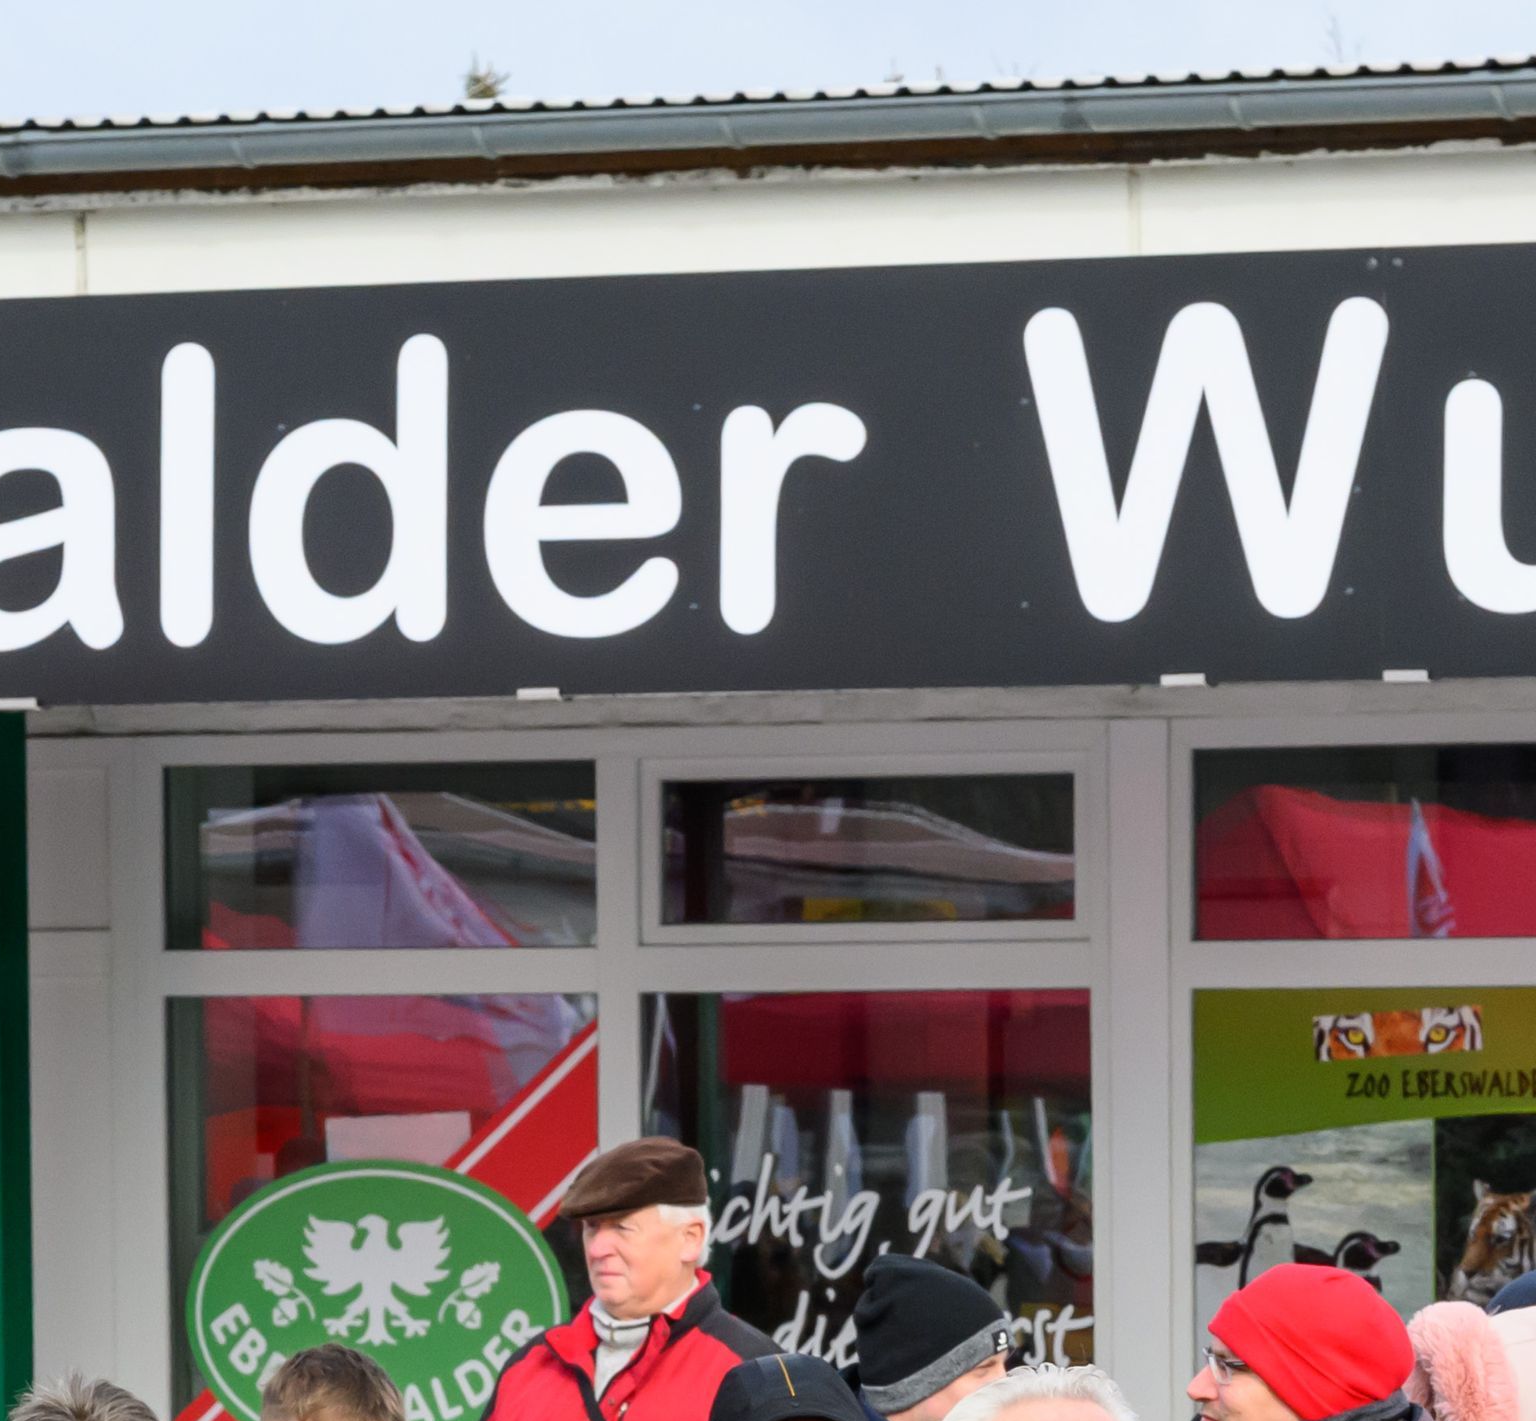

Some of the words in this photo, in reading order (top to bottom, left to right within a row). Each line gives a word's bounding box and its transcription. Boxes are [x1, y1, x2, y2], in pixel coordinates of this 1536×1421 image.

[1345, 1071, 1391, 1098] ZOO
[709, 1152, 880, 1281] chtig
[878, 1177, 1032, 1259] gut
